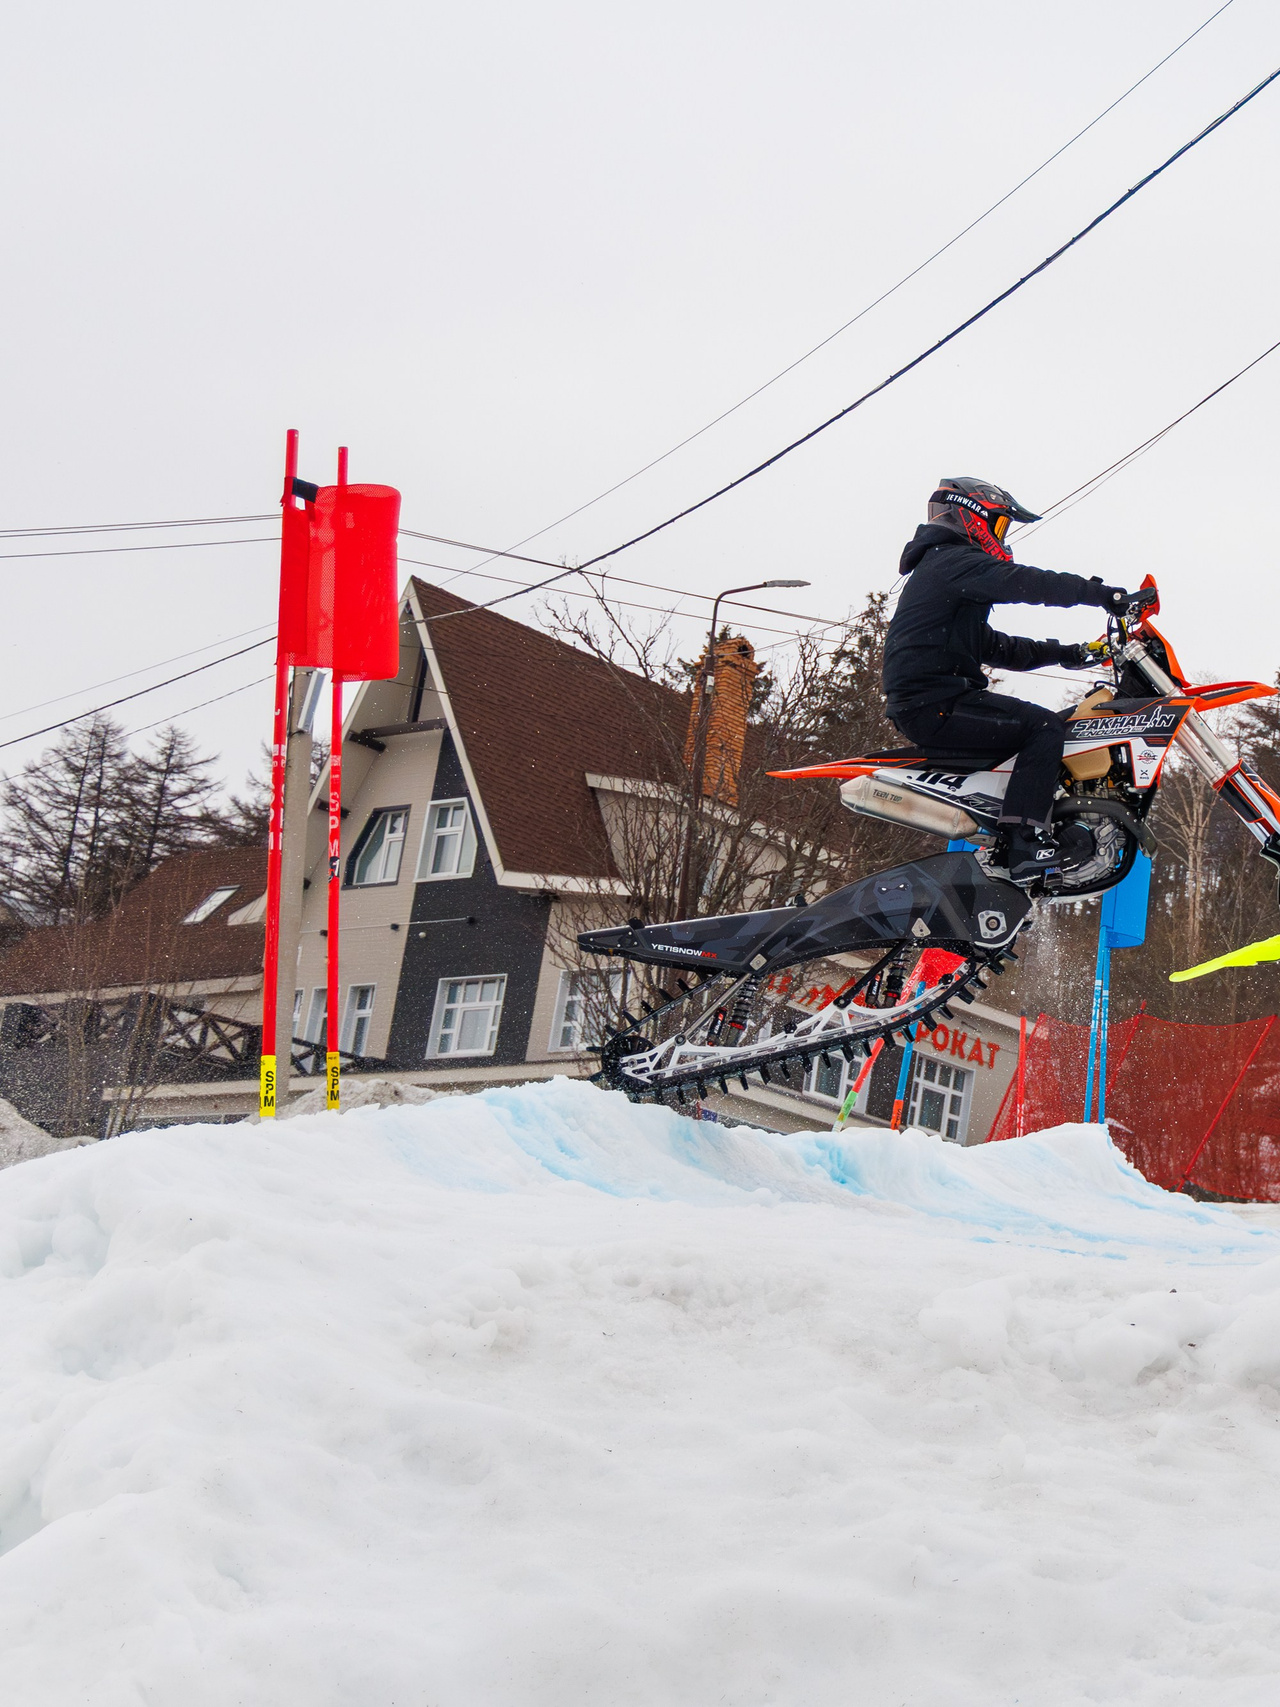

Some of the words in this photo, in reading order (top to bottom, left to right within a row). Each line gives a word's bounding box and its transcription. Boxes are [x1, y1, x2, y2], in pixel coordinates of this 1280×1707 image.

[946, 493, 982, 513] JETHWEAR
[1071, 705, 1175, 732] SAKHALIN
[897, 1021, 1001, 1070] РОКАТ
[263, 1070, 275, 1108] SPM
[330, 1066, 340, 1101] SPM
